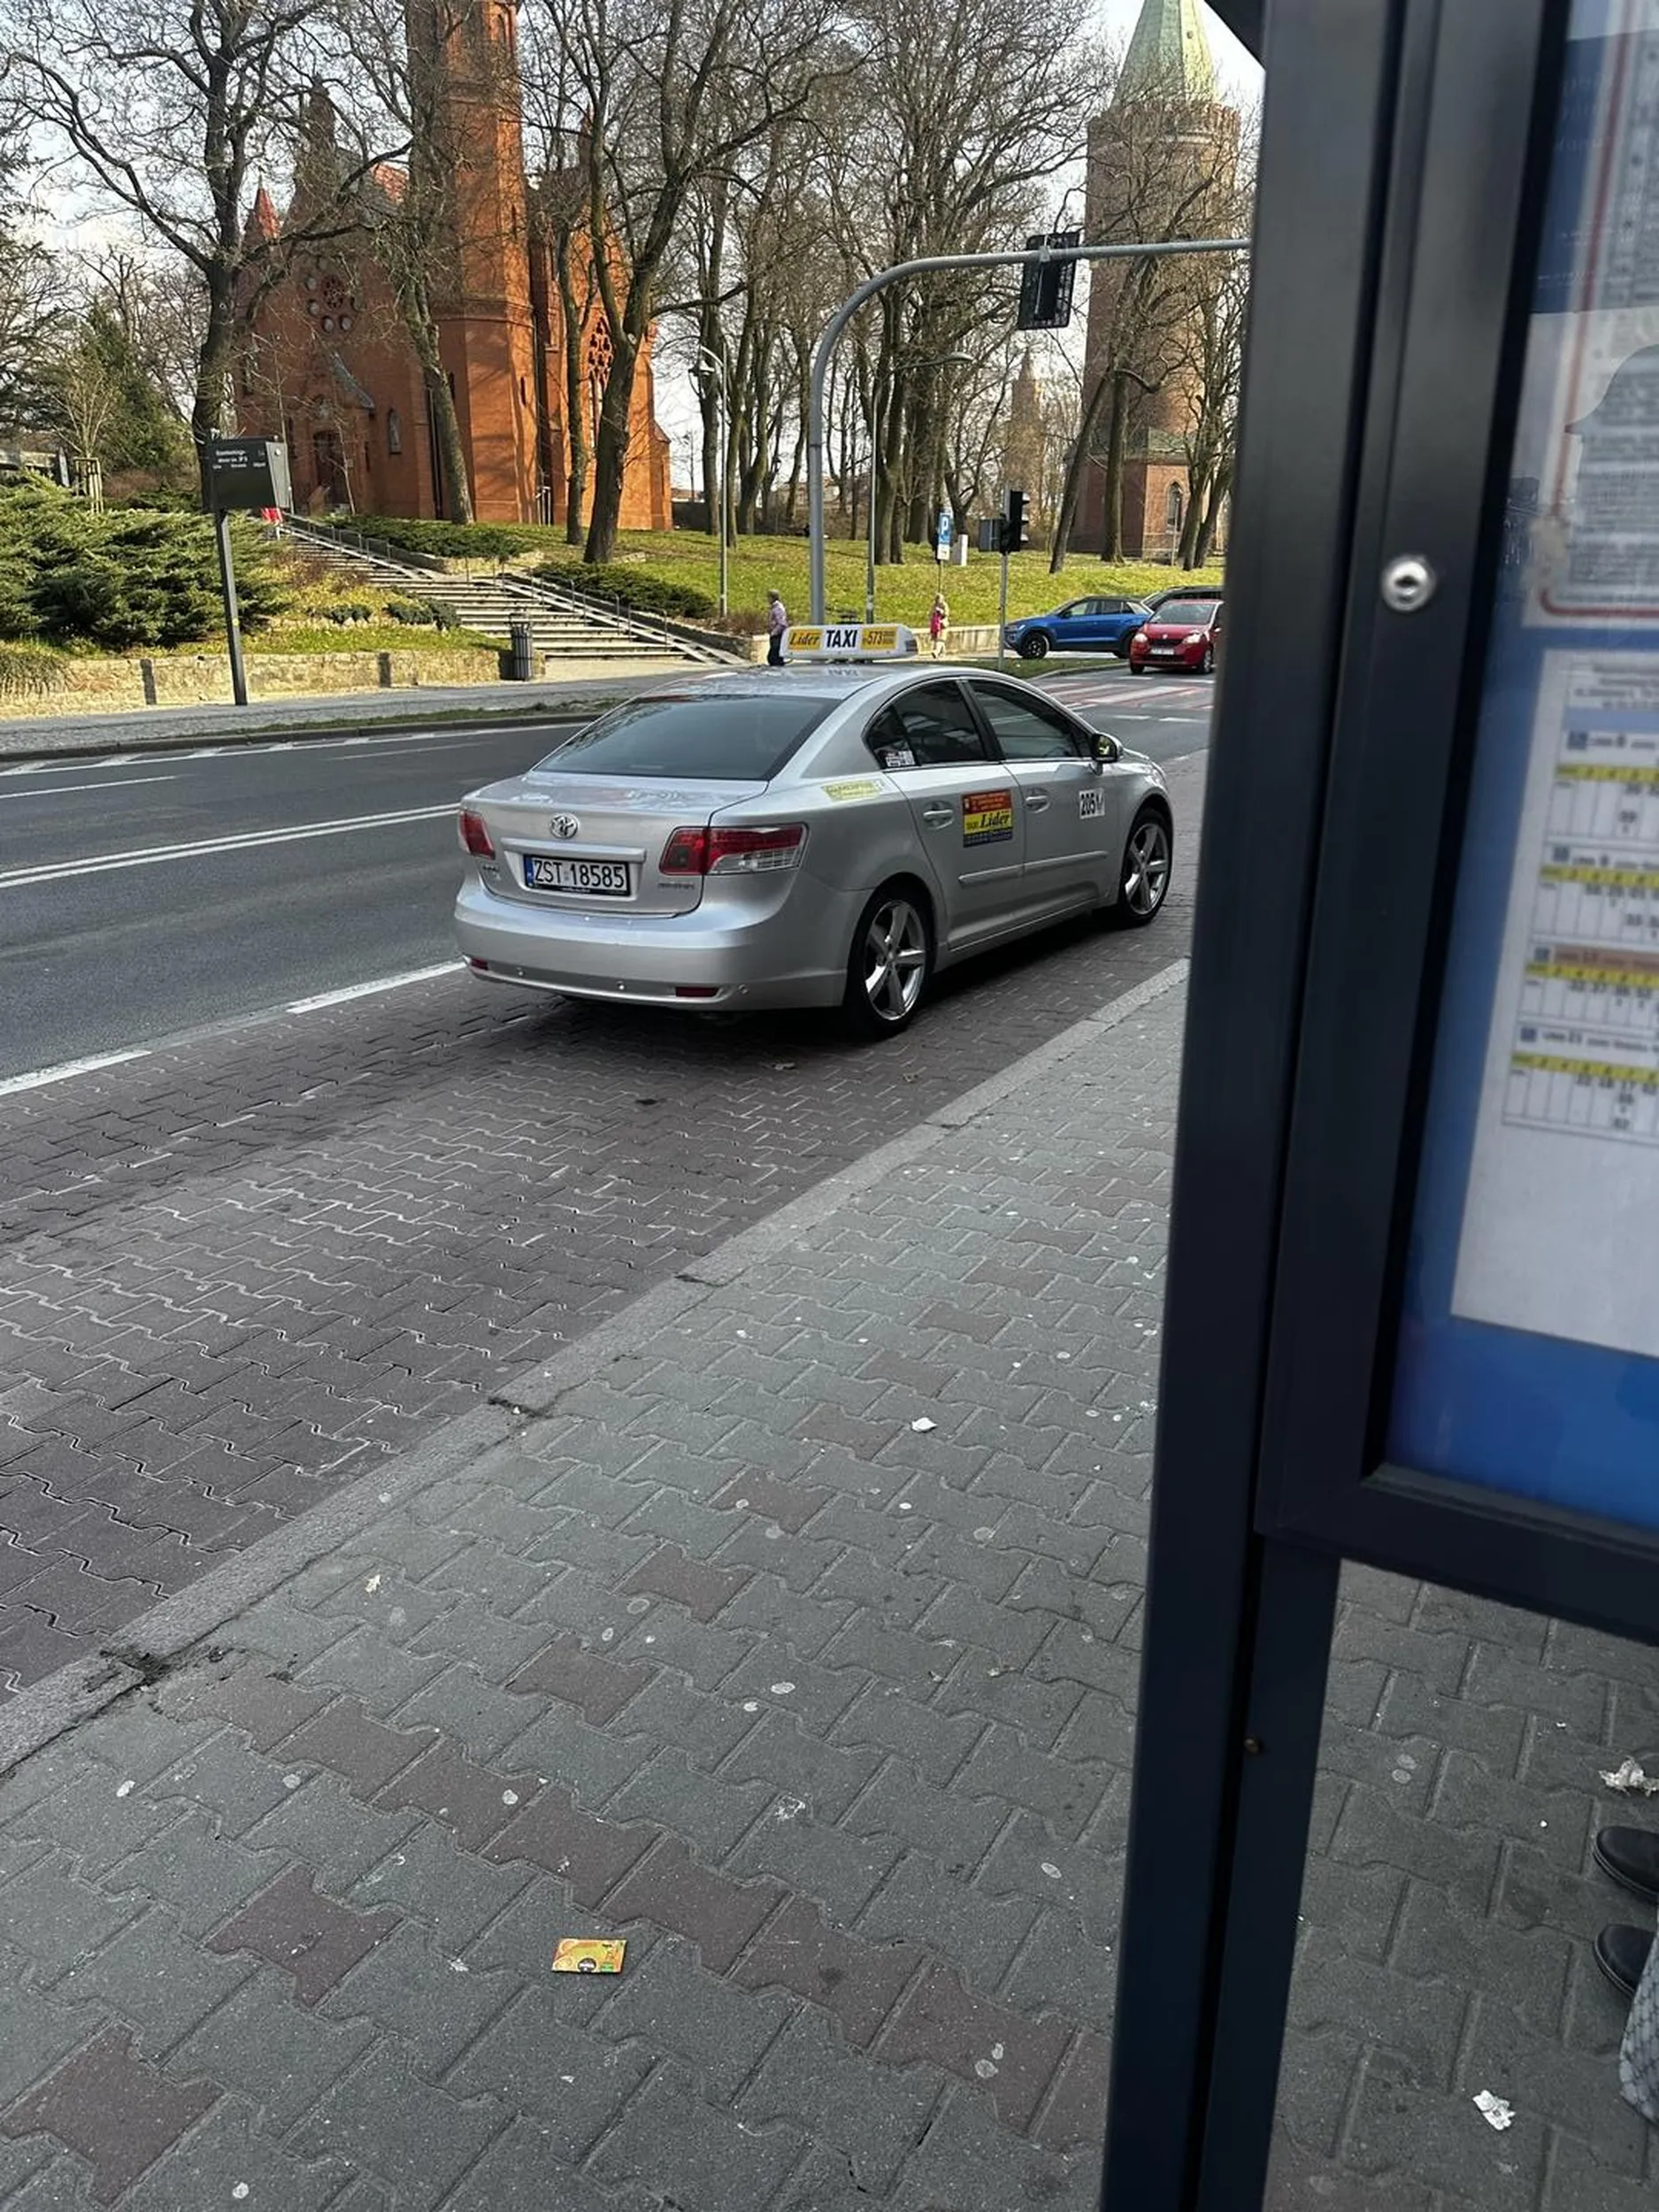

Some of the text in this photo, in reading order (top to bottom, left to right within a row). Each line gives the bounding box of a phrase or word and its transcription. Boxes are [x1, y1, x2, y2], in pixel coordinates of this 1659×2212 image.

[941, 516, 949, 535] P
[826, 629, 857, 648] TAXI
[979, 811, 1010, 828] Lider
[534, 859, 625, 888] ZST 18585
